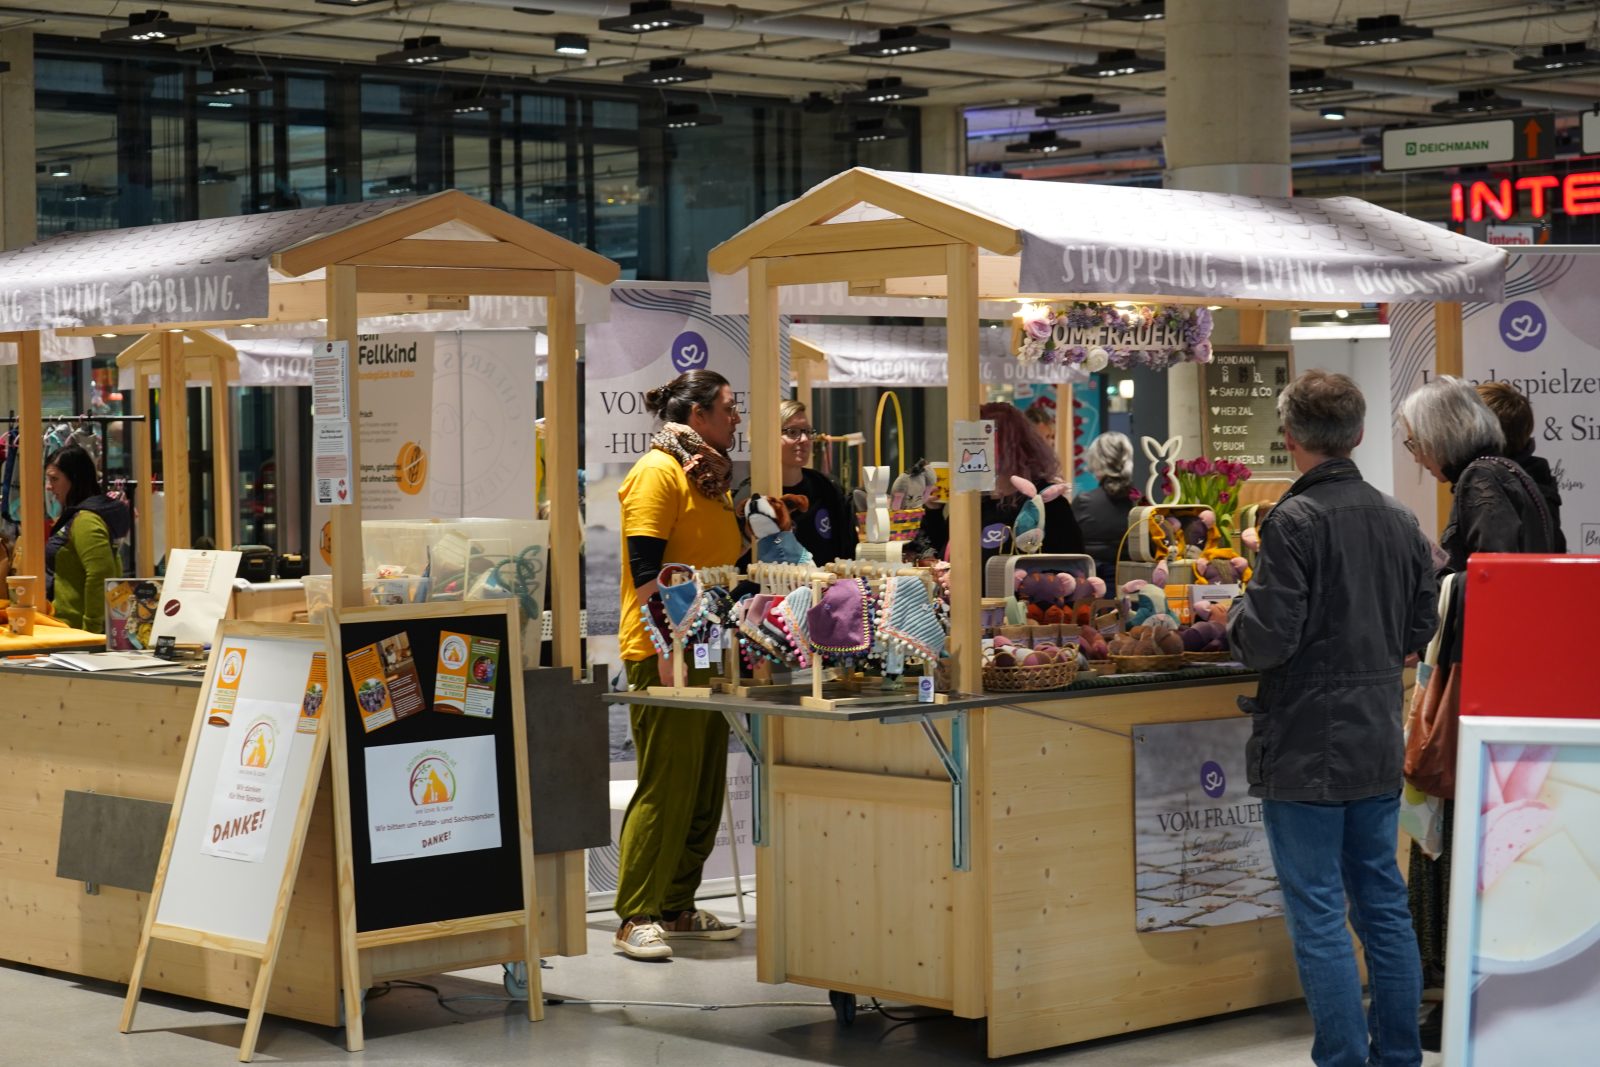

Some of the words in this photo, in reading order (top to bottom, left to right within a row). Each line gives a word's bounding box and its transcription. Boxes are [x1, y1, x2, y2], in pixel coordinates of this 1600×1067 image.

[1419, 140, 1490, 154] DEICHMANN
[1061, 244, 1229, 290] SHOPPING.
[1240, 254, 1346, 295] LIVING.
[40, 281, 120, 323] LIVING.
[130, 274, 241, 318] DÖBLING.
[358, 341, 418, 366] Fellkind
[1222, 425, 1249, 435] DECKE
[1543, 416, 1563, 442] &
[1222, 441, 1245, 451] BUCH
[212, 809, 267, 844] DANKE!
[1157, 810, 1200, 833] VOM
[421, 830, 452, 849] DANKE!
